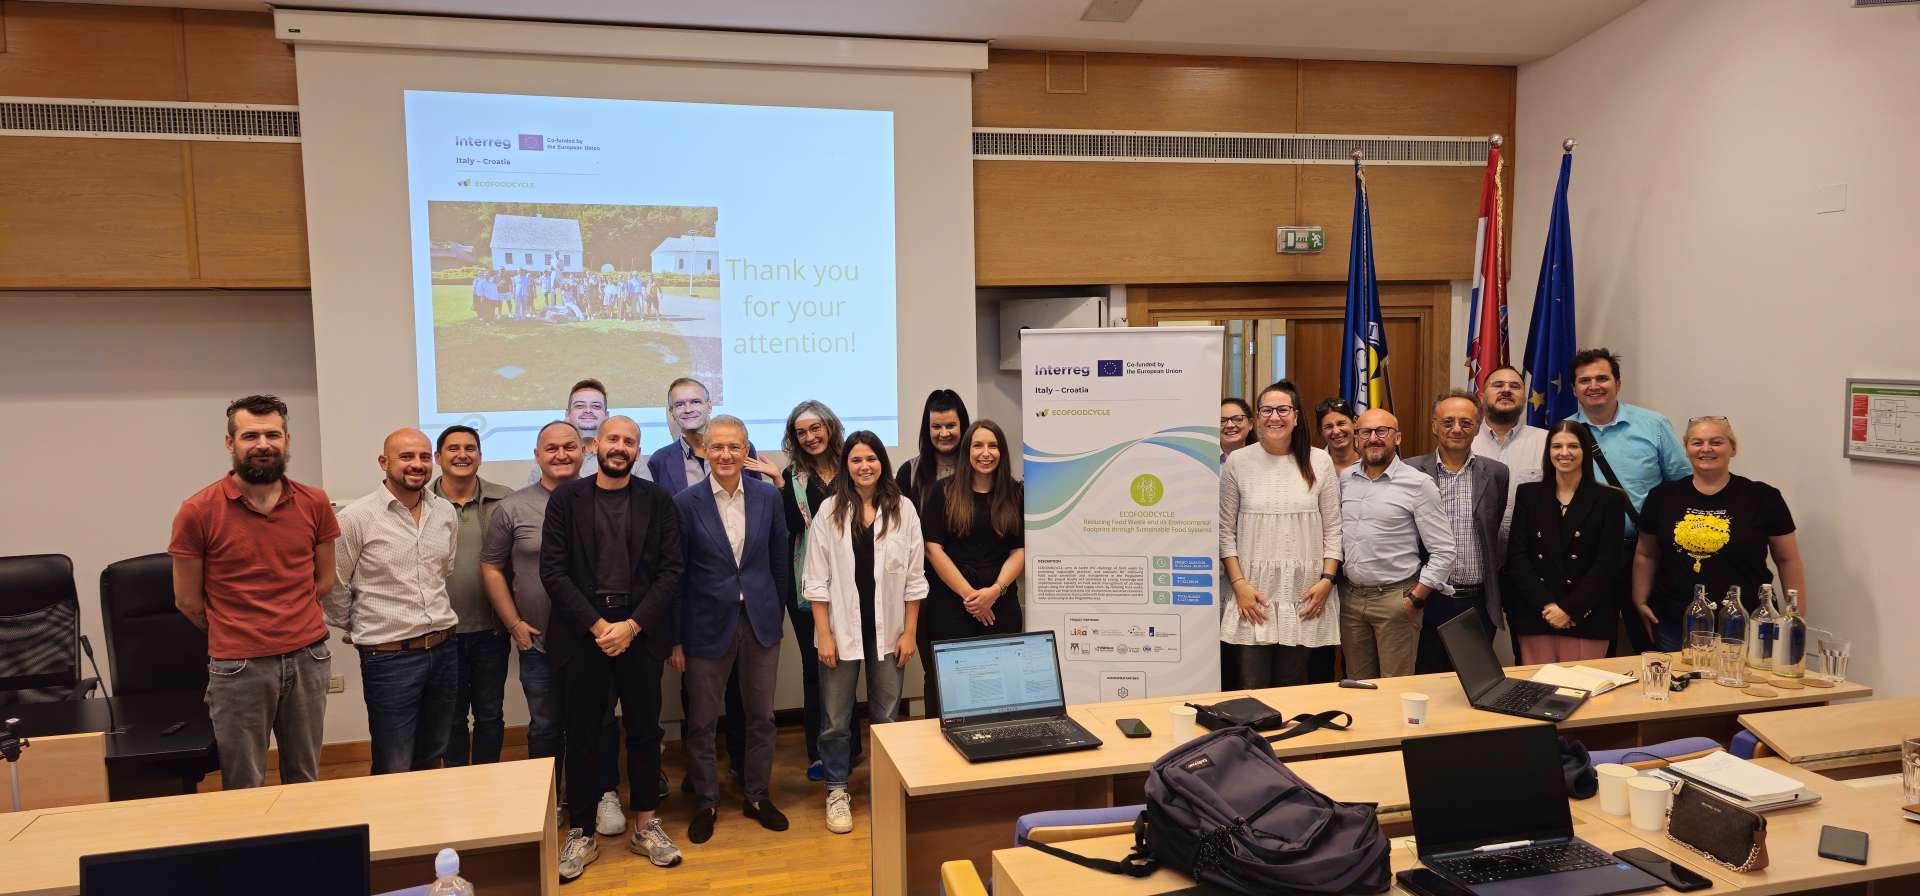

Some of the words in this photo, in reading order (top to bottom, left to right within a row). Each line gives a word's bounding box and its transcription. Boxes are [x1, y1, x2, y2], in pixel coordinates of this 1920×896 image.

[455, 135, 511, 149] Interreg
[456, 157, 475, 165] Italy
[475, 180, 534, 188] ECOFOODCYCLE
[725, 258, 806, 281] Thank
[813, 264, 859, 287] you
[743, 295, 781, 317] for
[787, 300, 847, 323] your
[733, 332, 856, 354] attention!
[1035, 365, 1090, 376] Interreg
[1035, 387, 1053, 395] Italy
